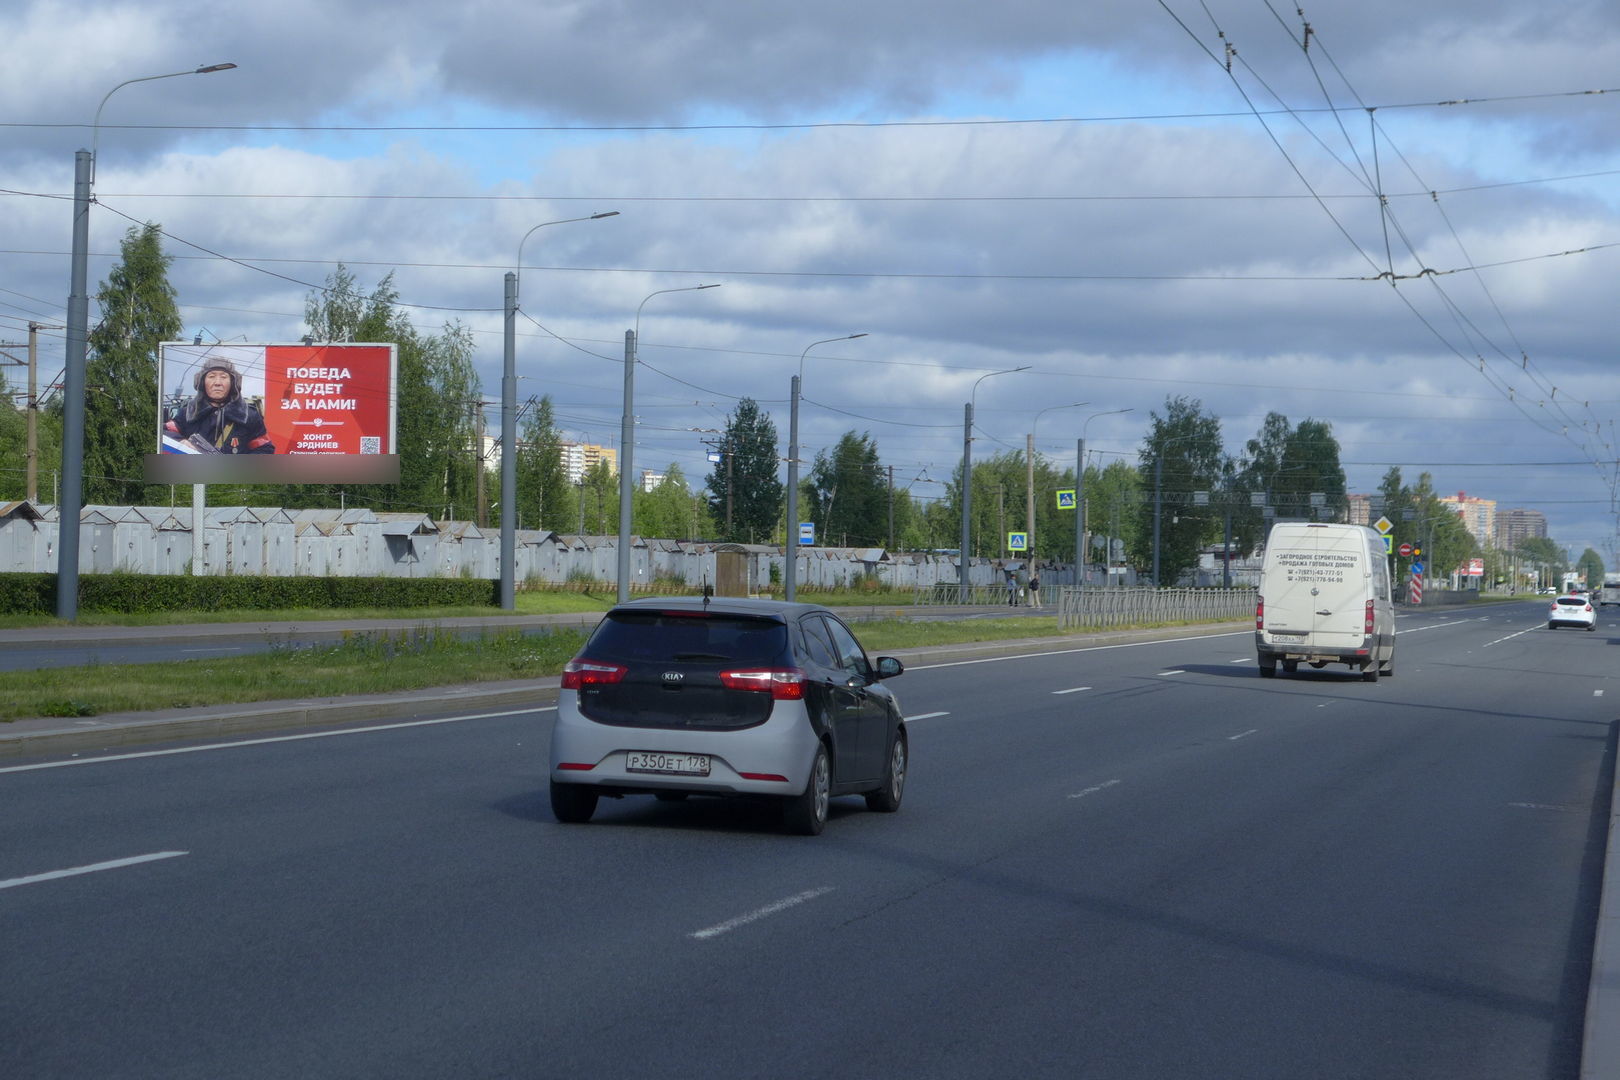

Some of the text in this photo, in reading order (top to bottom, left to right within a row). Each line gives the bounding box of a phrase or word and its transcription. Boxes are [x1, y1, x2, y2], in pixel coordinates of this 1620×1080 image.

[286, 367, 351, 380] ПОБЕДА
[294, 383, 343, 395] БУДЕТ
[280, 399, 356, 410] ЗА НАМИ!
[664, 673, 680, 681] KIA
[687, 756, 706, 768] 178
